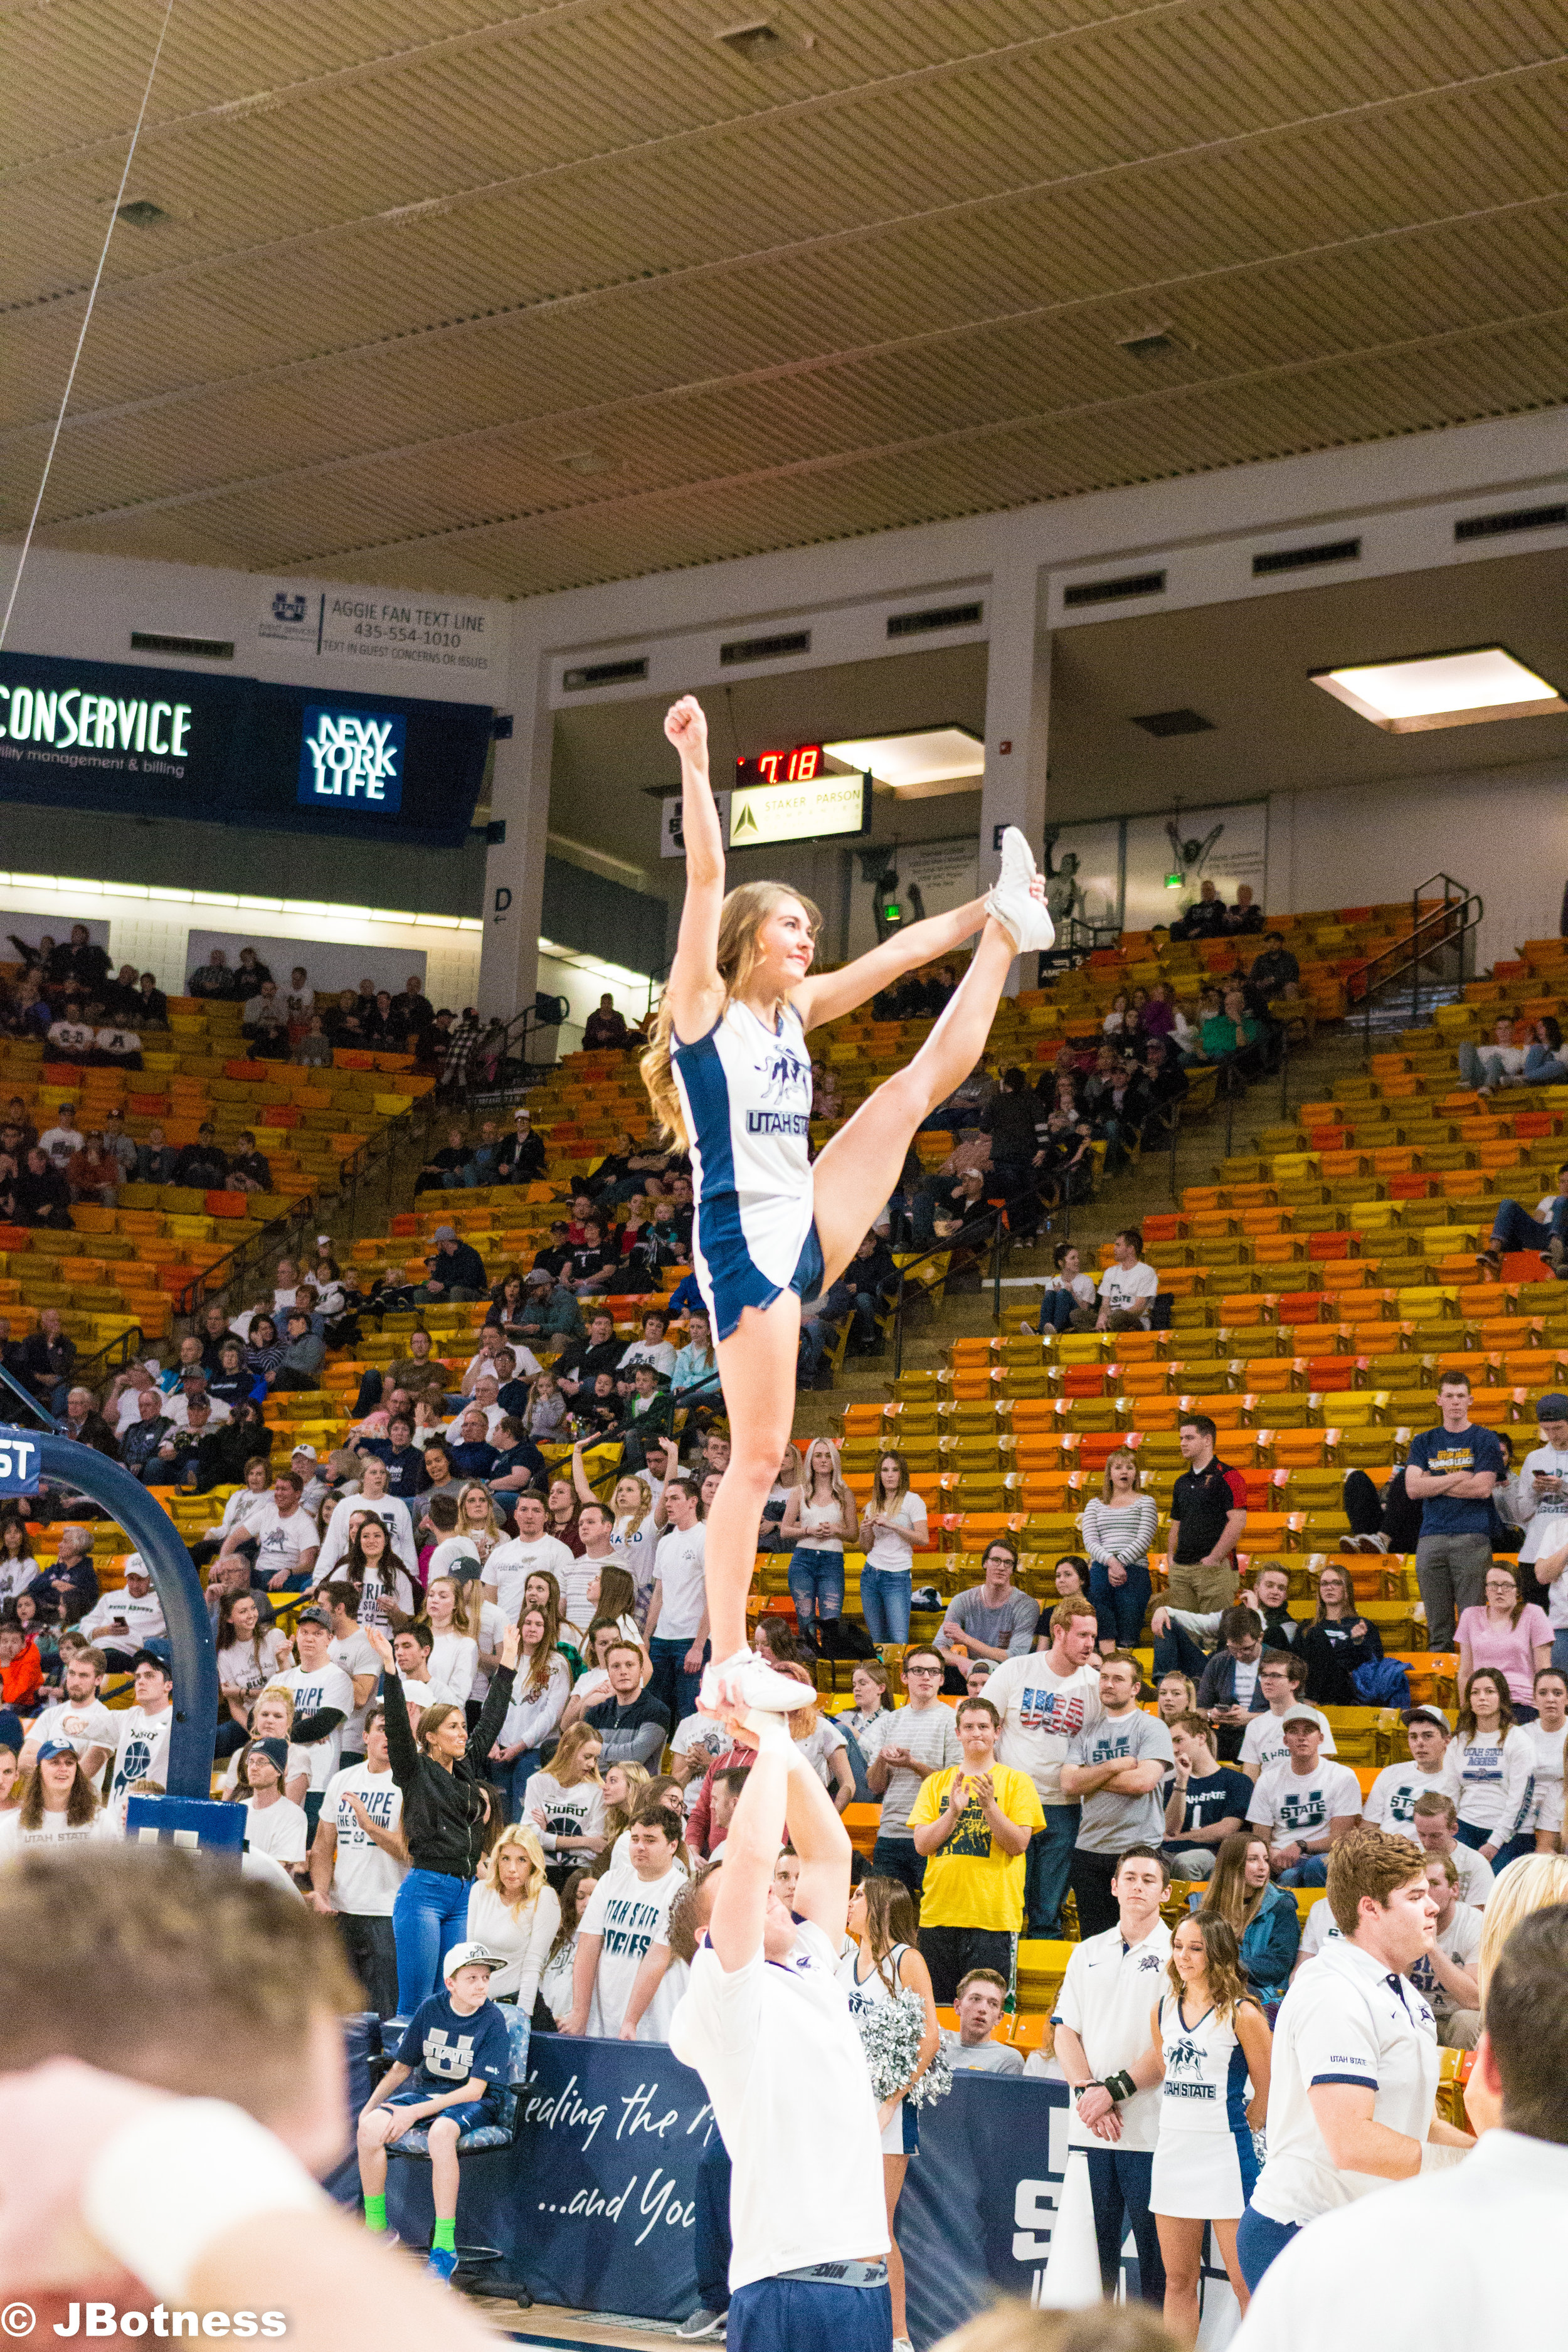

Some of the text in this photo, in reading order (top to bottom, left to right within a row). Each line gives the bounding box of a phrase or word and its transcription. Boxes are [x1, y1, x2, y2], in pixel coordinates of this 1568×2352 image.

[332, 599, 485, 633] AGGIE FAN TEXT LINE
[353, 622, 462, 649] 435-554-1010
[322, 638, 489, 670] TEXT IN GUEST CONCERNS OR ISSUES
[317, 714, 393, 750] NEW
[28, 749, 124, 770] management
[127, 758, 139, 771] &
[143, 760, 185, 778] billing
[305, 736, 398, 778] YORK
[314, 763, 385, 800] LIFE
[765, 788, 861, 812] STAKER PARSON
[495, 887, 512, 912] D
[748, 1111, 791, 1133] UTAH
[1020, 1687, 1084, 1738] USA
[1199, 1791, 1226, 1801] STATE
[337, 1815, 349, 1827] THE
[1280, 1800, 1327, 1820] STATE
[24, 1832, 91, 1843] UTAH STATE
[423, 2040, 474, 2067] STATE
[1350, 2057, 1368, 2067] STATE
[1165, 2081, 1215, 2099] TAH STATE
[616, 2083, 679, 2140] the
